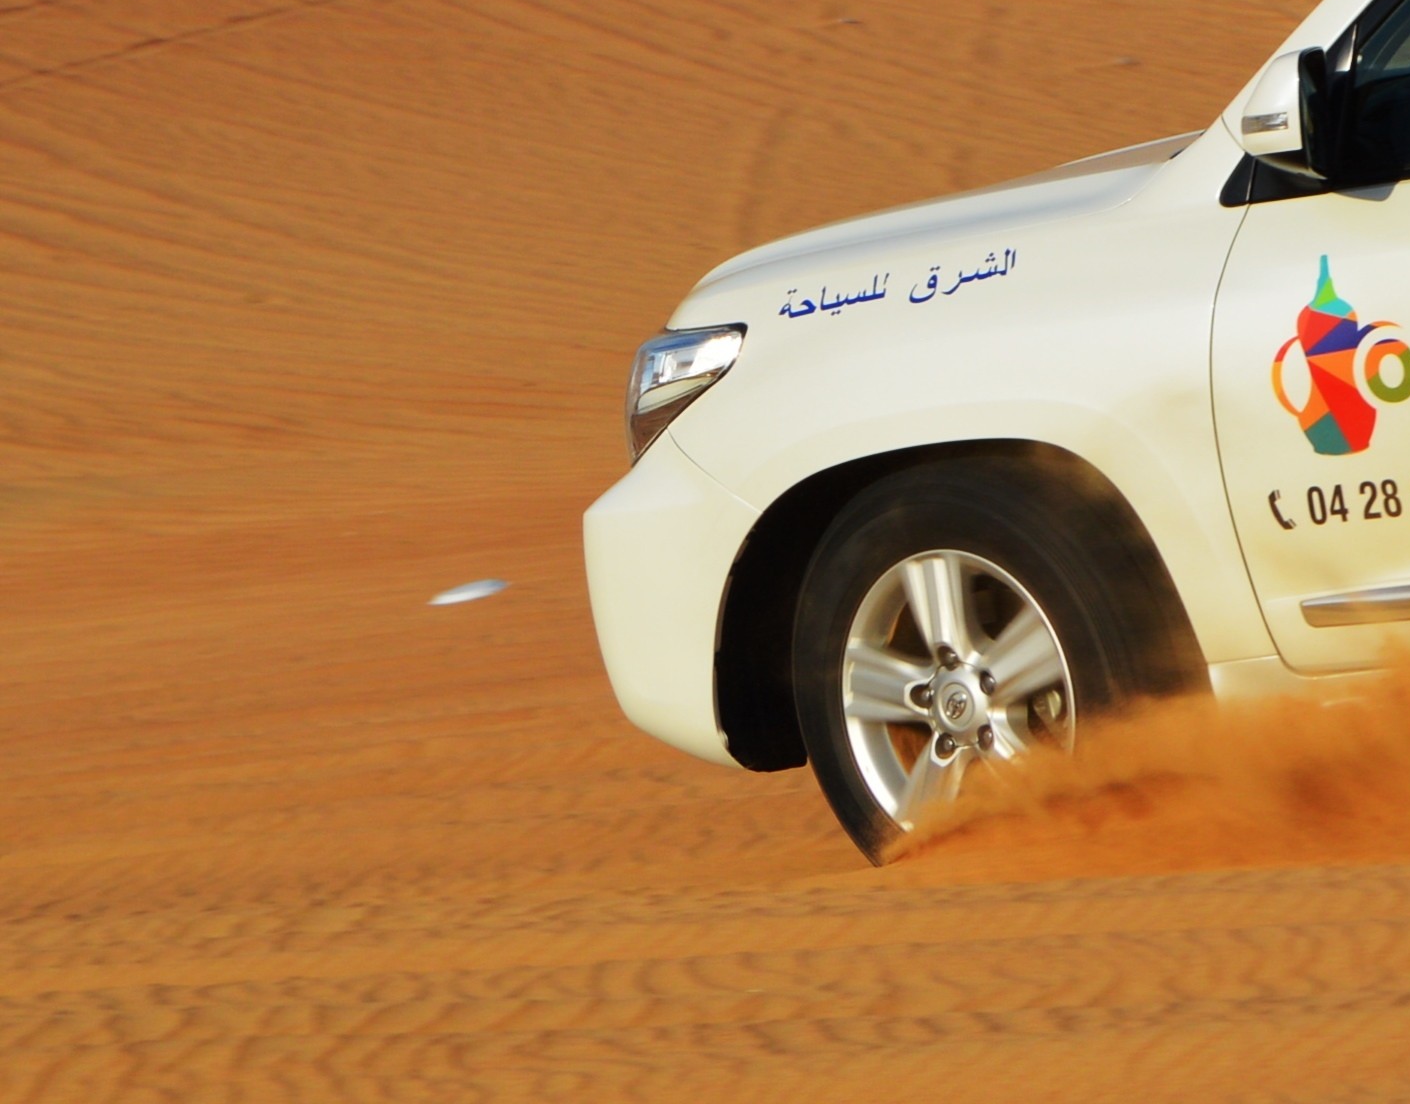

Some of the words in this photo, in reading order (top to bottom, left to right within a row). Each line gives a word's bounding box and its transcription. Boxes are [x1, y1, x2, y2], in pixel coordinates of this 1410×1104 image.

[777, 272, 891, 319] للسياحة
[908, 248, 1017, 304] الشرق
[1306, 483, 1349, 526] 04
[1358, 479, 1403, 520] 28
